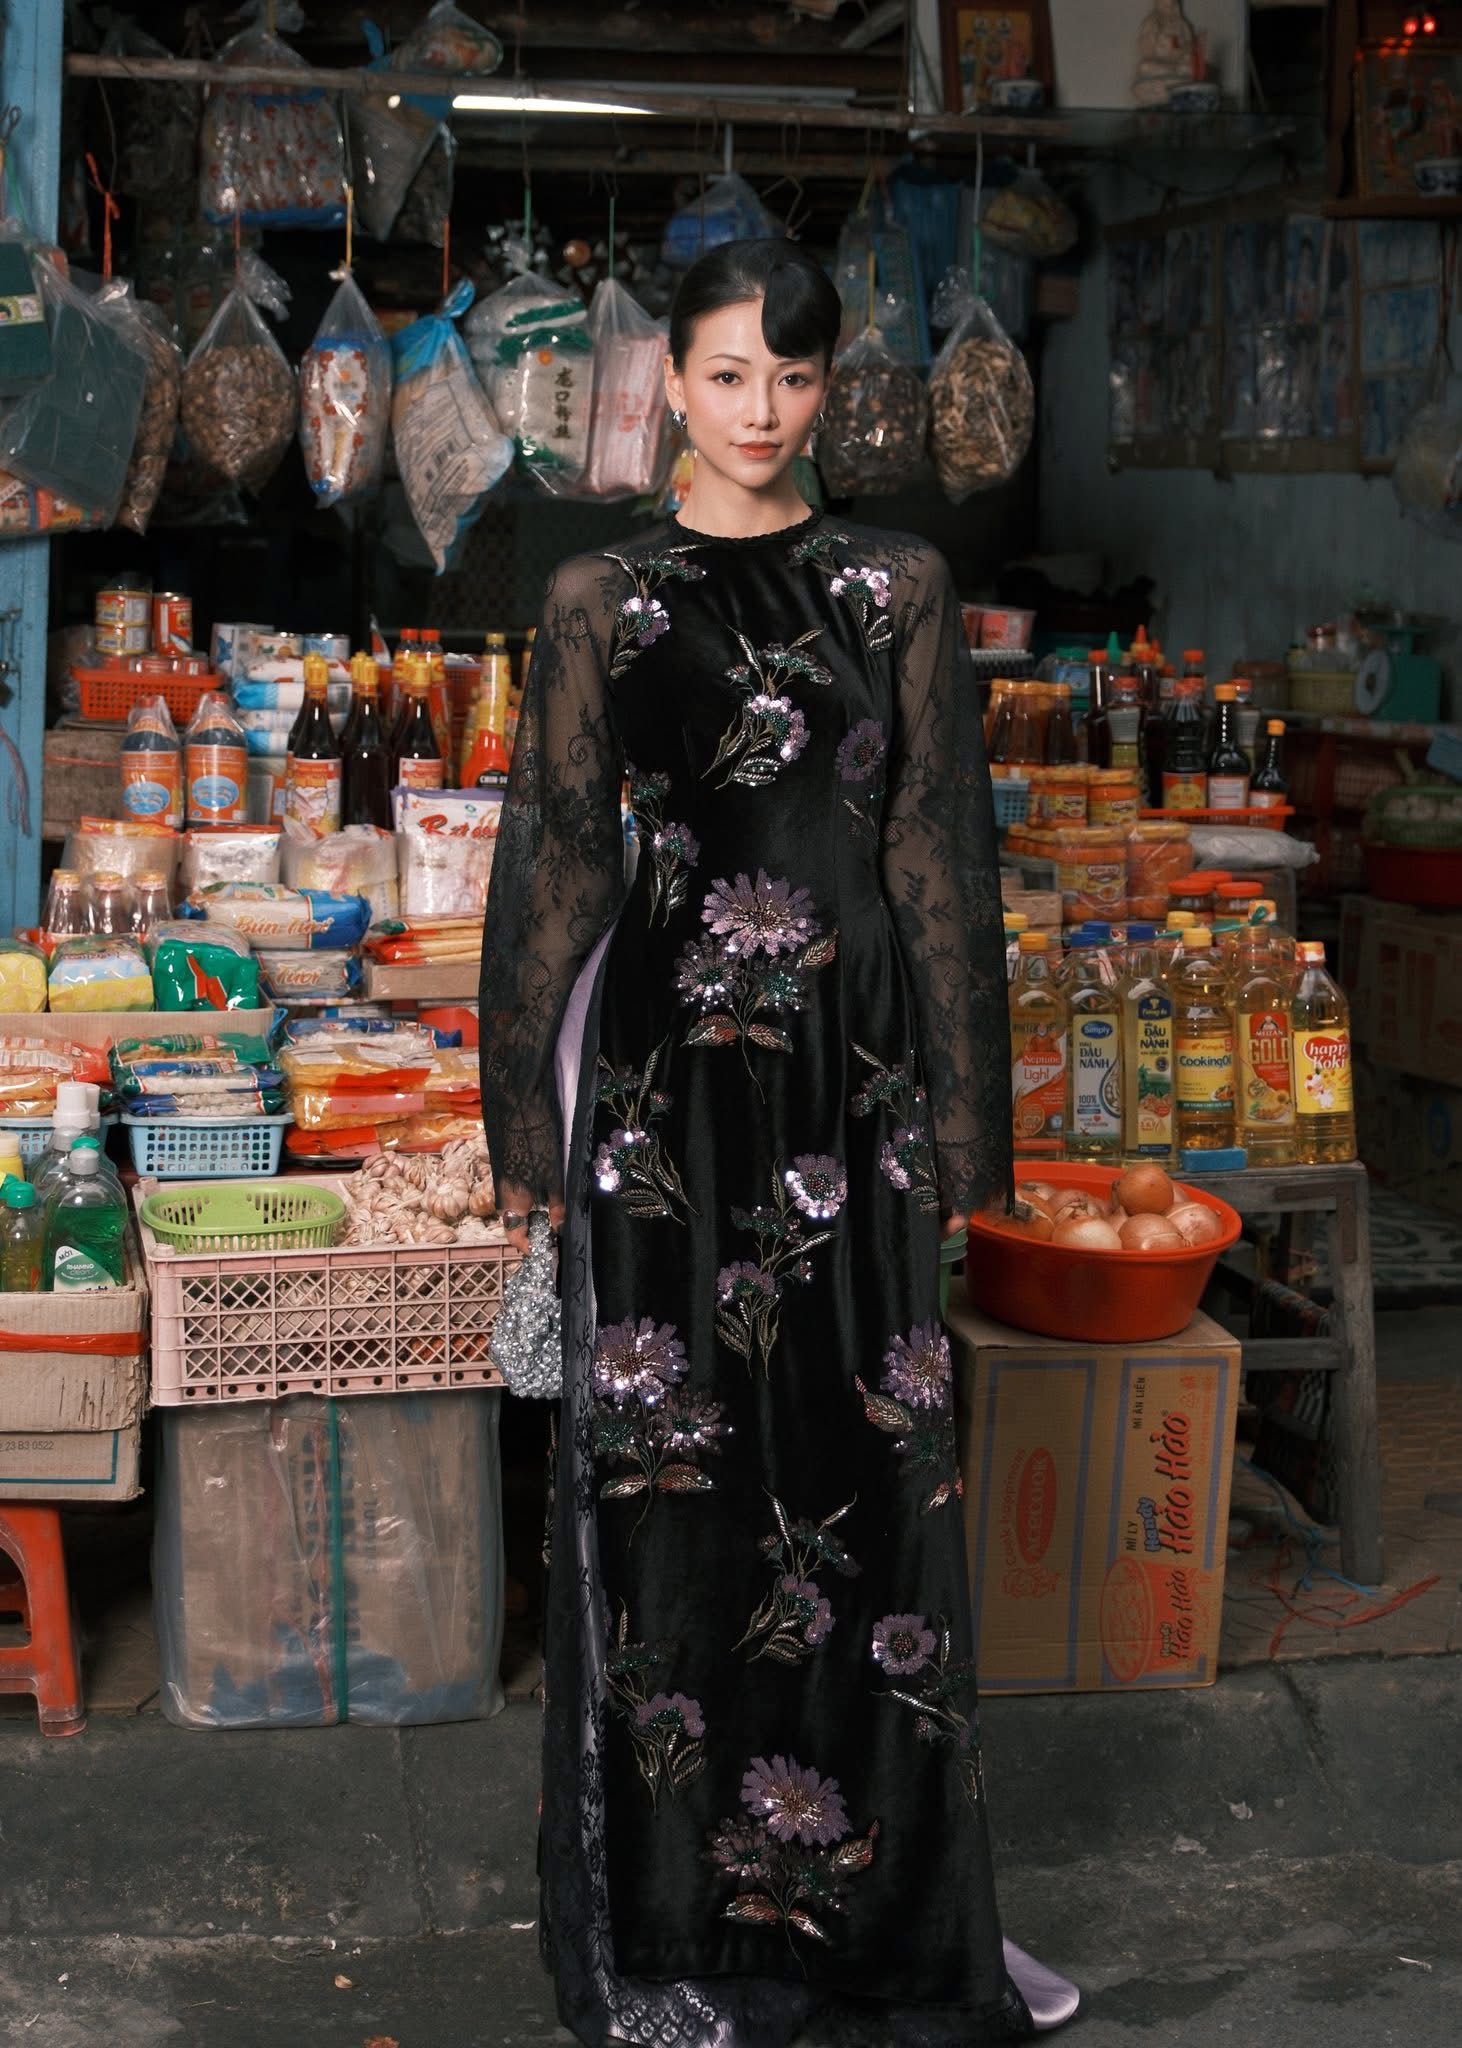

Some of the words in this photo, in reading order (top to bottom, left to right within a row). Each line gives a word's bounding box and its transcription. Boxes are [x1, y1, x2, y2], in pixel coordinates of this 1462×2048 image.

[235, 915, 279, 935] Bún
[1083, 1024, 1111, 1036] Simply
[1248, 1037, 1291, 1063] GOLD
[1023, 1055, 1061, 1066] Neptune
[1313, 1054, 1345, 1069] Koki
[1024, 1068, 1050, 1082] Light
[32, 1440, 54, 1450] 0522
[1149, 1411, 1192, 1480] Hảo
[1153, 1484, 1195, 1554] Hảo
[1127, 1520, 1138, 1535] LY
